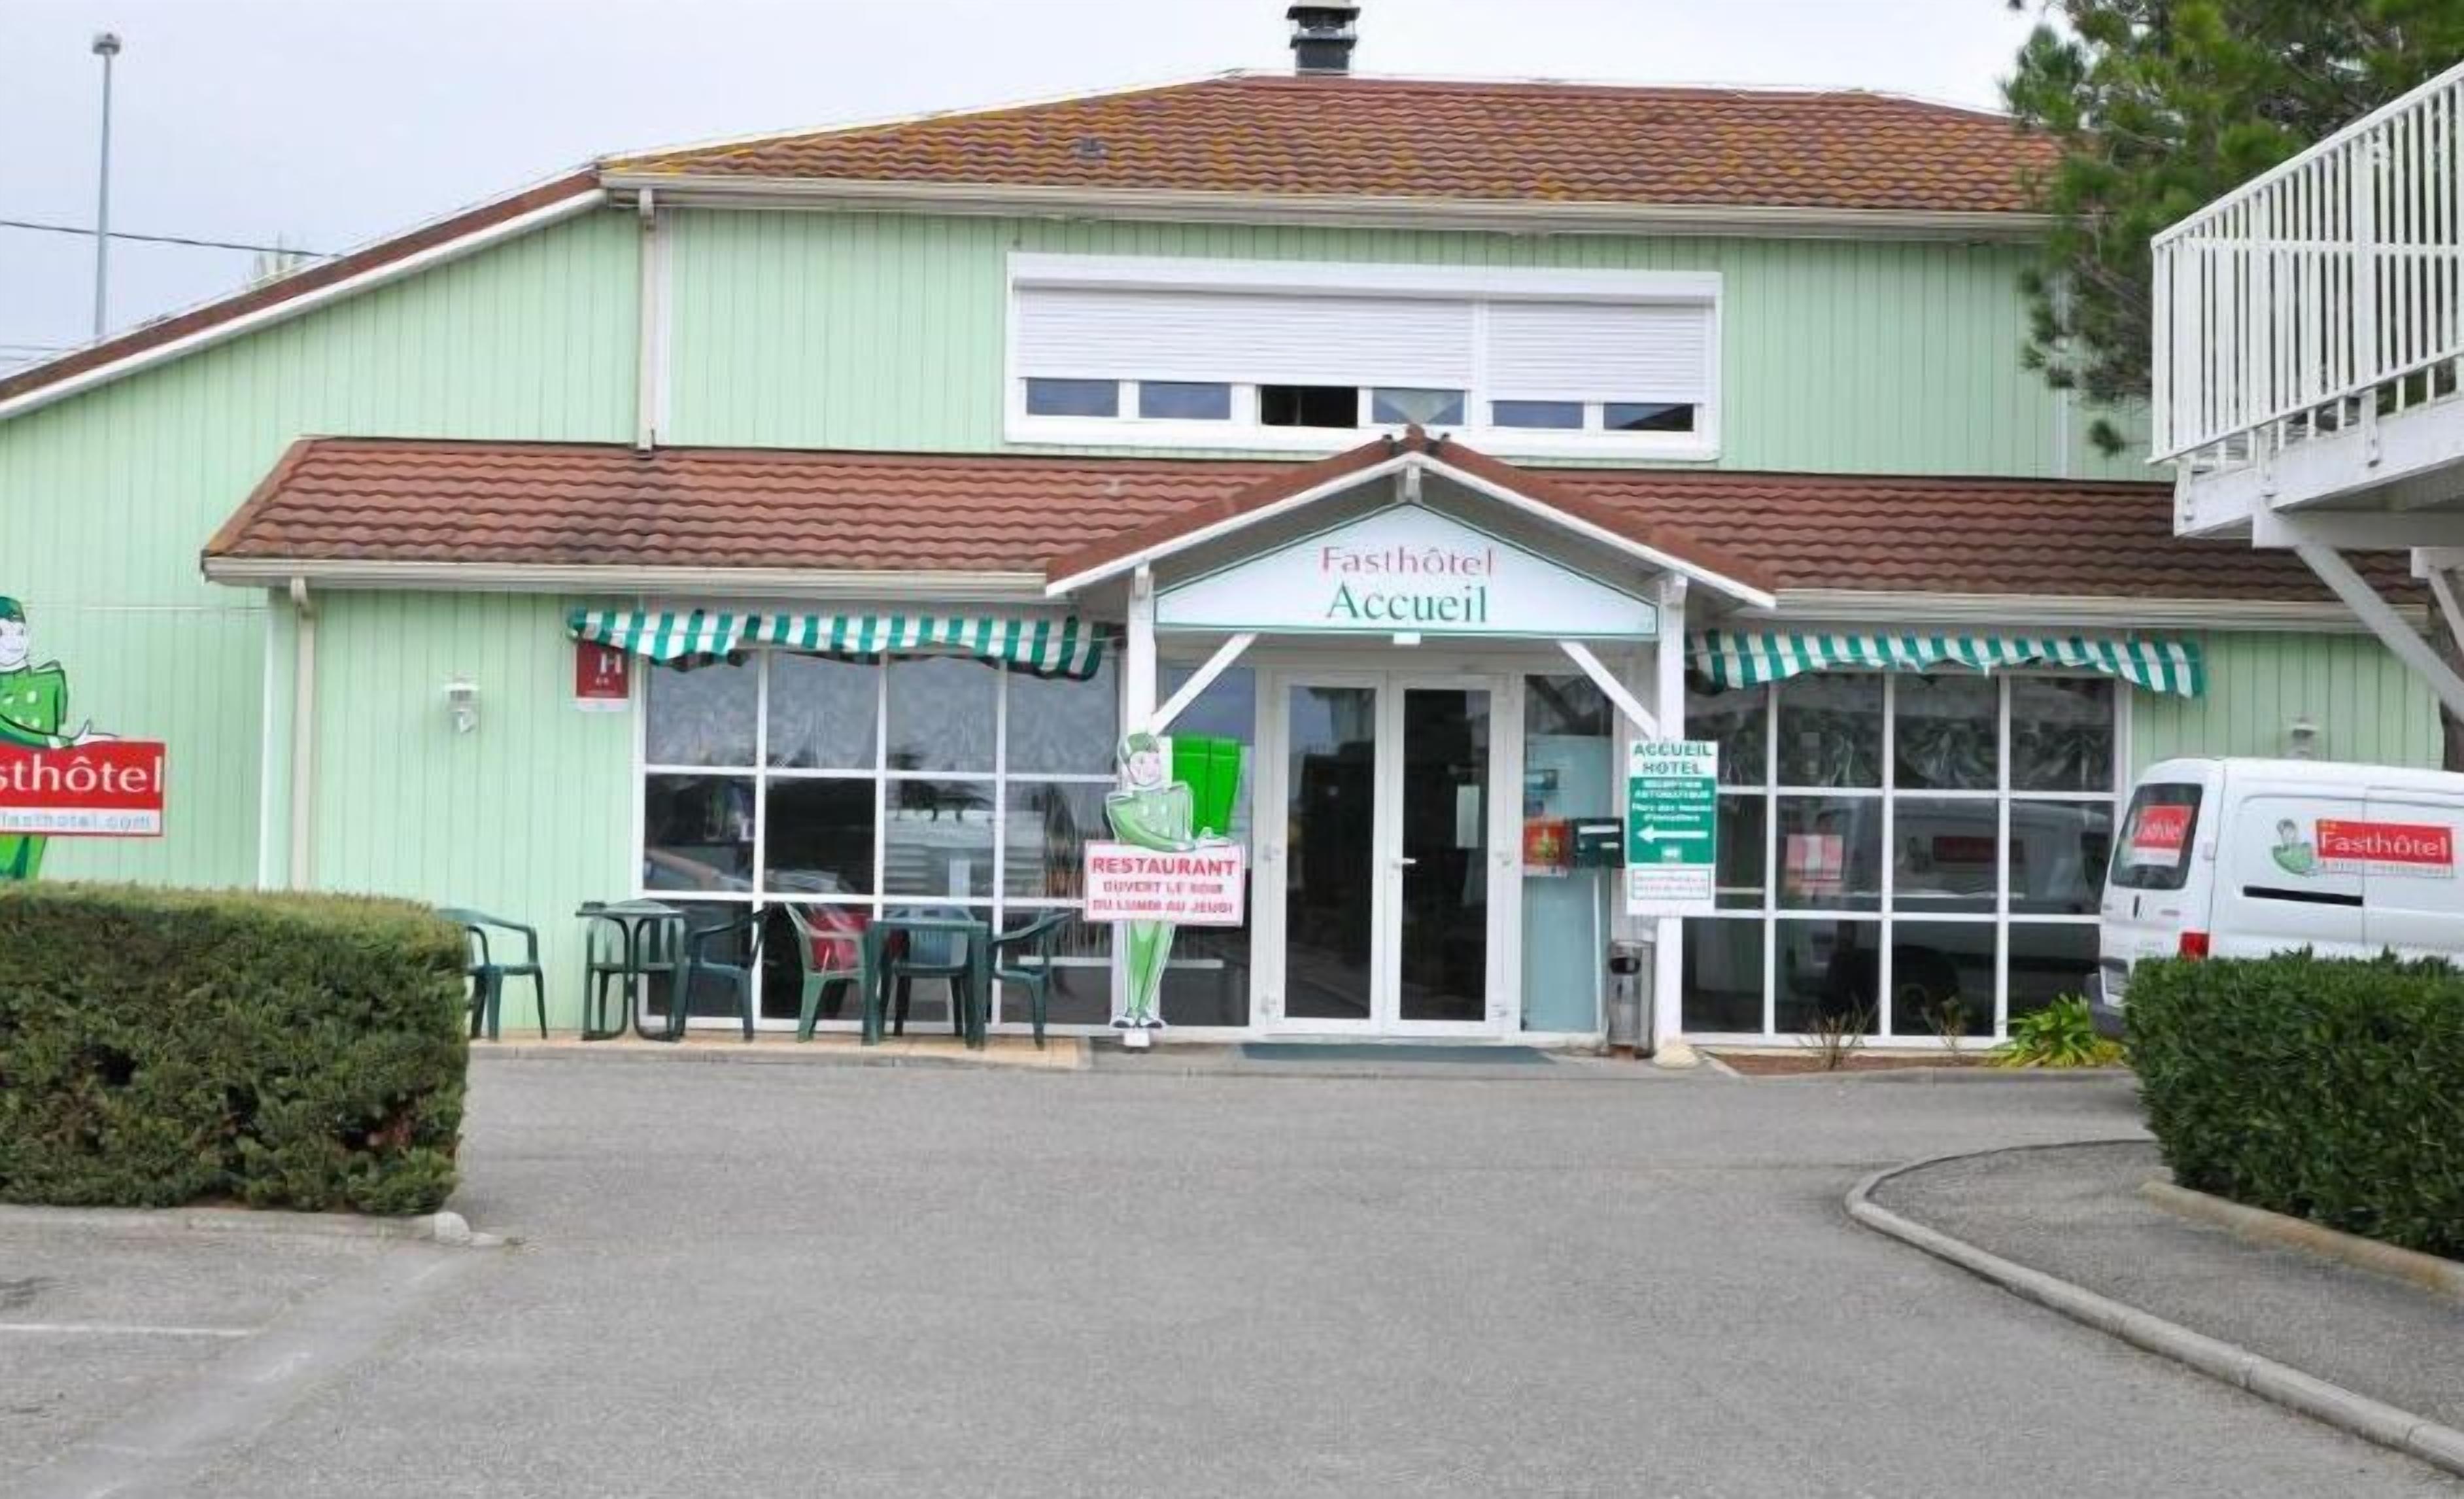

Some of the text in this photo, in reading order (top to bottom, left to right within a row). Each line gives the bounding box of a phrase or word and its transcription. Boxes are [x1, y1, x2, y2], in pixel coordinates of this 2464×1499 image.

[1322, 545, 1492, 576] Fasthôtel
[1326, 581, 1486, 623] Accueil
[1634, 743, 1713, 757] ACCUEIL
[1642, 761, 1703, 775] HOTEL
[2321, 829, 2448, 859] Fasthôtel
[1092, 857, 1236, 876] RESTAURANT
[1103, 880, 1161, 893] OUVERT
[1166, 881, 1182, 895] LE
[1093, 899, 1233, 914] DU LUNDI AU JEUDI
